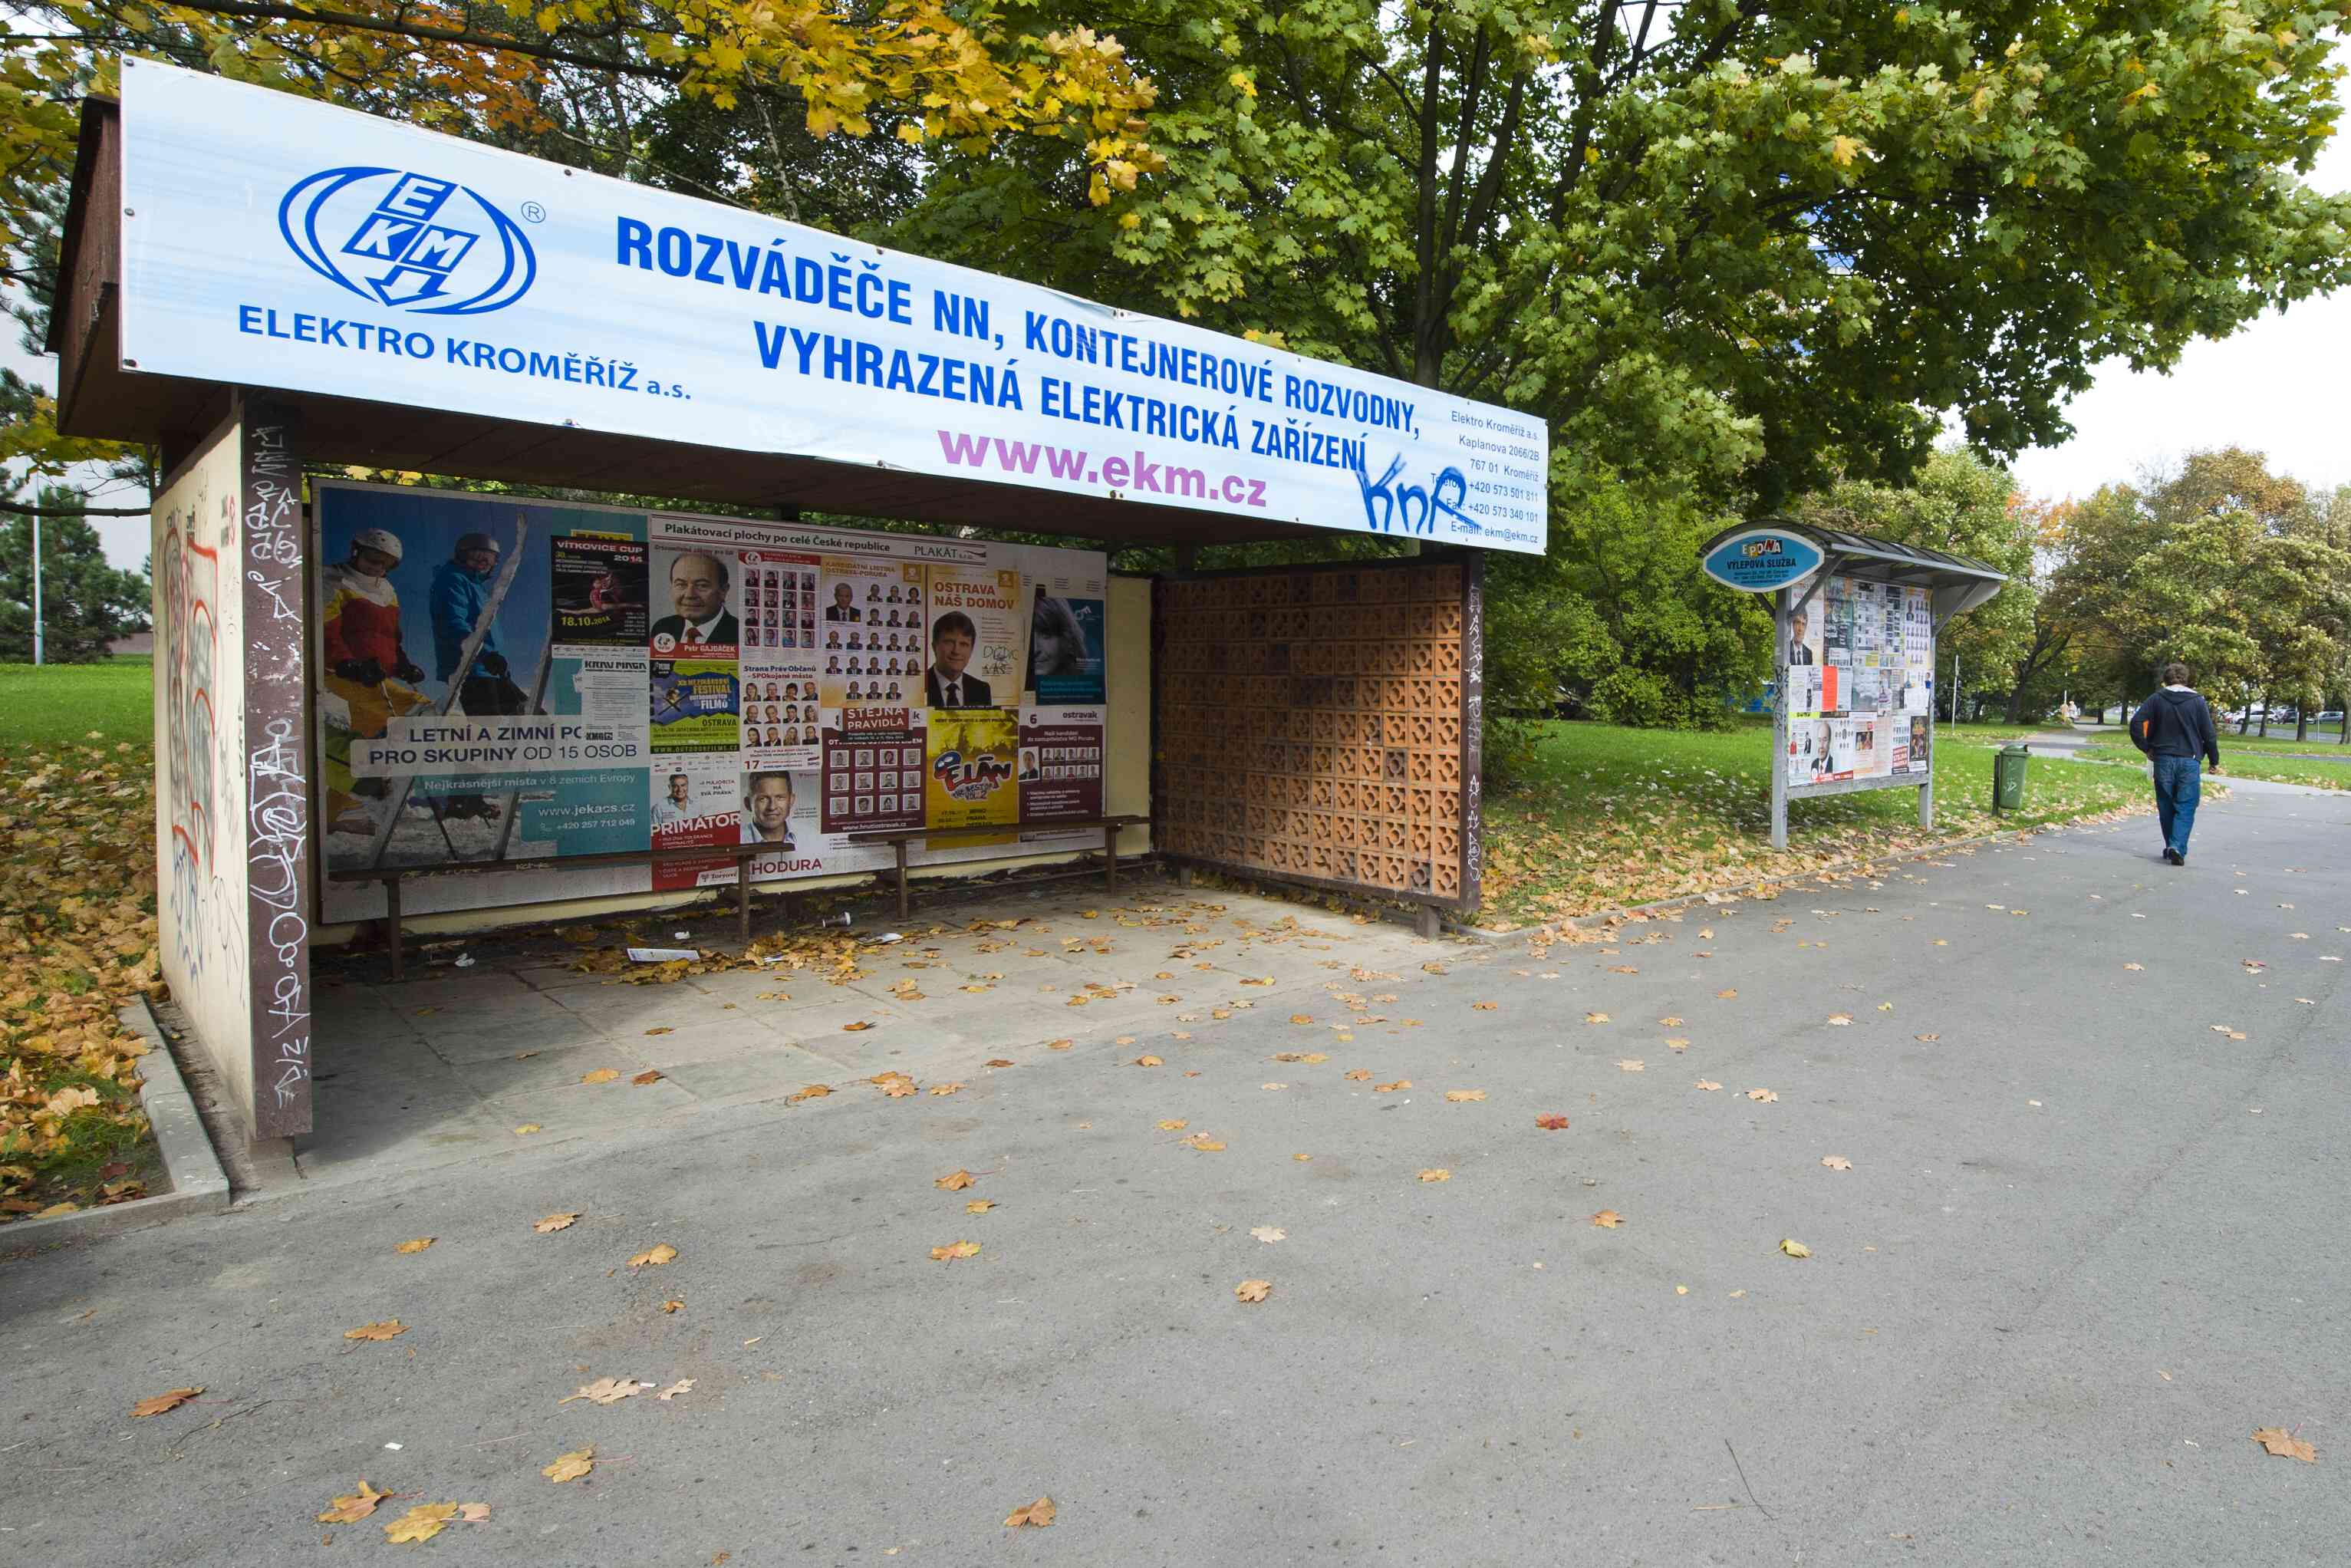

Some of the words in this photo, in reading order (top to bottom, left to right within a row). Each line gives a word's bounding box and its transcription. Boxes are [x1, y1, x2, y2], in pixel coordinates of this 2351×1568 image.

[617, 216, 912, 325] ROZVÁDĚČE
[933, 289, 1004, 351] NN,
[1025, 310, 1273, 403] KONTEJNEROVÉ
[1286, 374, 1419, 440] ROZVODNY,
[239, 305, 435, 359] ELEKTRO
[446, 338, 639, 392] KROMĚŘÍŽ
[647, 378, 691, 400] a.s.
[753, 321, 1023, 410] VYHRAZENÁ
[1040, 376, 1240, 450] ELEKTRICKÁ
[1251, 417, 1368, 473] ZAŘÍZENÍ
[1451, 410, 1483, 428] Elektro
[1459, 435, 1506, 454] Kaplanova
[937, 429, 1267, 509] www.ekm.cz
[1470, 458, 1486, 472] 767
[1489, 461, 1498, 473] 01
[1469, 479, 1490, 493] +420
[1493, 483, 1508, 496] 573
[1510, 486, 1524, 499] 501
[1468, 502, 1490, 516] +420
[1493, 505, 1508, 518] 573
[1510, 508, 1524, 521] 340
[1526, 510, 1538, 523] 101
[665, 523, 732, 538] Plakátovací
[735, 530, 770, 543] plochy
[774, 535, 787, 545] po
[790, 535, 810, 545] celé
[813, 535, 842, 548] České
[845, 539, 890, 552] republice
[1451, 521, 1482, 537] E-mail:
[1485, 525, 1538, 544] ekm@ekm.cz
[557, 541, 617, 552] VÍTKOVICE
[614, 554, 643, 563] 2014
[1767, 557, 1796, 568] SLUŽBA
[934, 581, 996, 596] OSTRAVA
[934, 594, 962, 607] NÁŠ
[966, 597, 1014, 610] DOMOV
[702, 718, 736, 726] OSTRAVA
[848, 718, 904, 730] PRAVIDLA
[1029, 714, 1037, 725] 6
[1062, 711, 1098, 720] ostravak
[410, 724, 473, 743] LETNÍ
[477, 727, 491, 741] A
[497, 723, 555, 741] ZIMNÍ
[370, 749, 417, 765] PRO
[423, 746, 518, 763] SKUPINY
[524, 746, 552, 760] OD
[559, 746, 578, 759] 15
[584, 743, 637, 759] OSOB
[744, 760, 760, 770] 17
[424, 776, 502, 792] Nejkrásnější
[505, 776, 536, 787] místa
[601, 772, 636, 785] Evropy
[538, 802, 636, 817] www.jekacs.cz
[581, 820, 598, 828] 257
[601, 819, 617, 828] 712
[650, 812, 741, 836] PRIMÁTOR
[752, 858, 822, 875] HODURA
